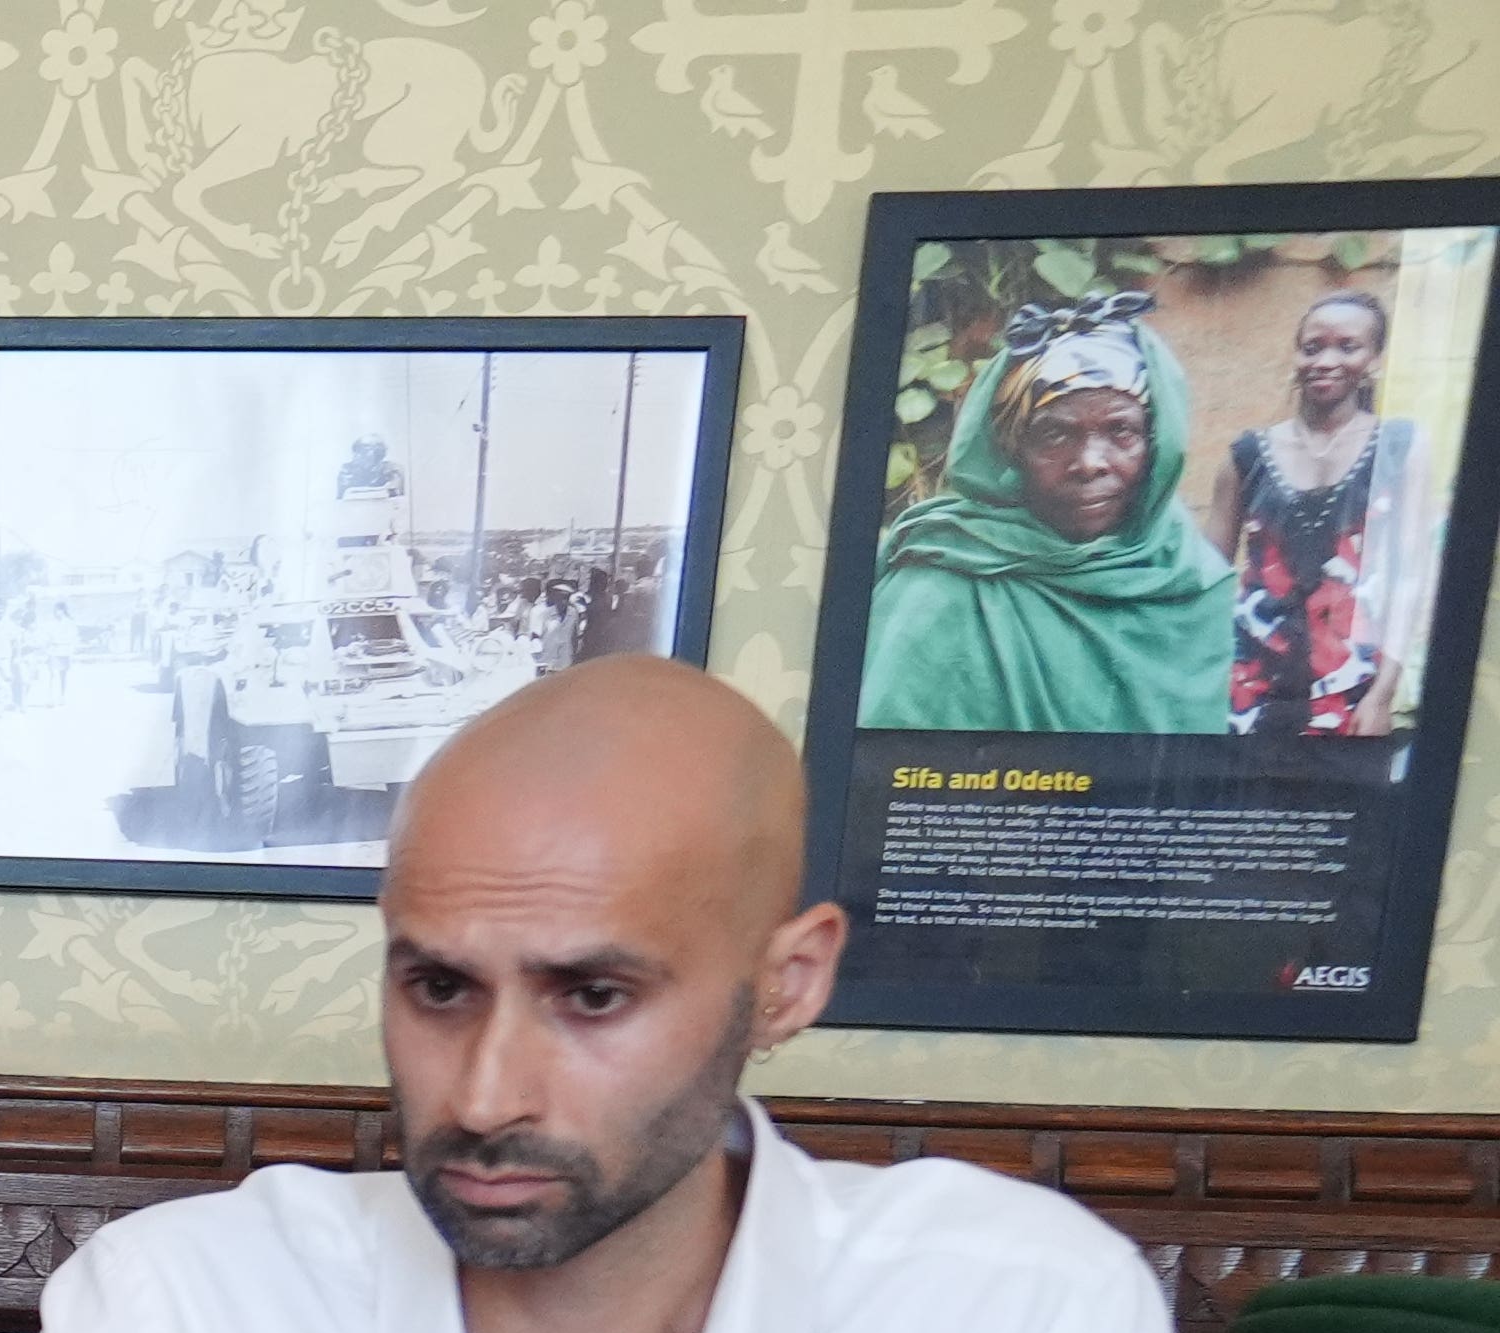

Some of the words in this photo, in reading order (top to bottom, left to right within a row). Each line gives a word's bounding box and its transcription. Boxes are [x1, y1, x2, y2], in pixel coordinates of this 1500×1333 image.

[892, 766, 944, 789] Sifa
[949, 770, 999, 790] and
[1003, 770, 1093, 791] Odette
[1294, 966, 1372, 986] AEGIS
